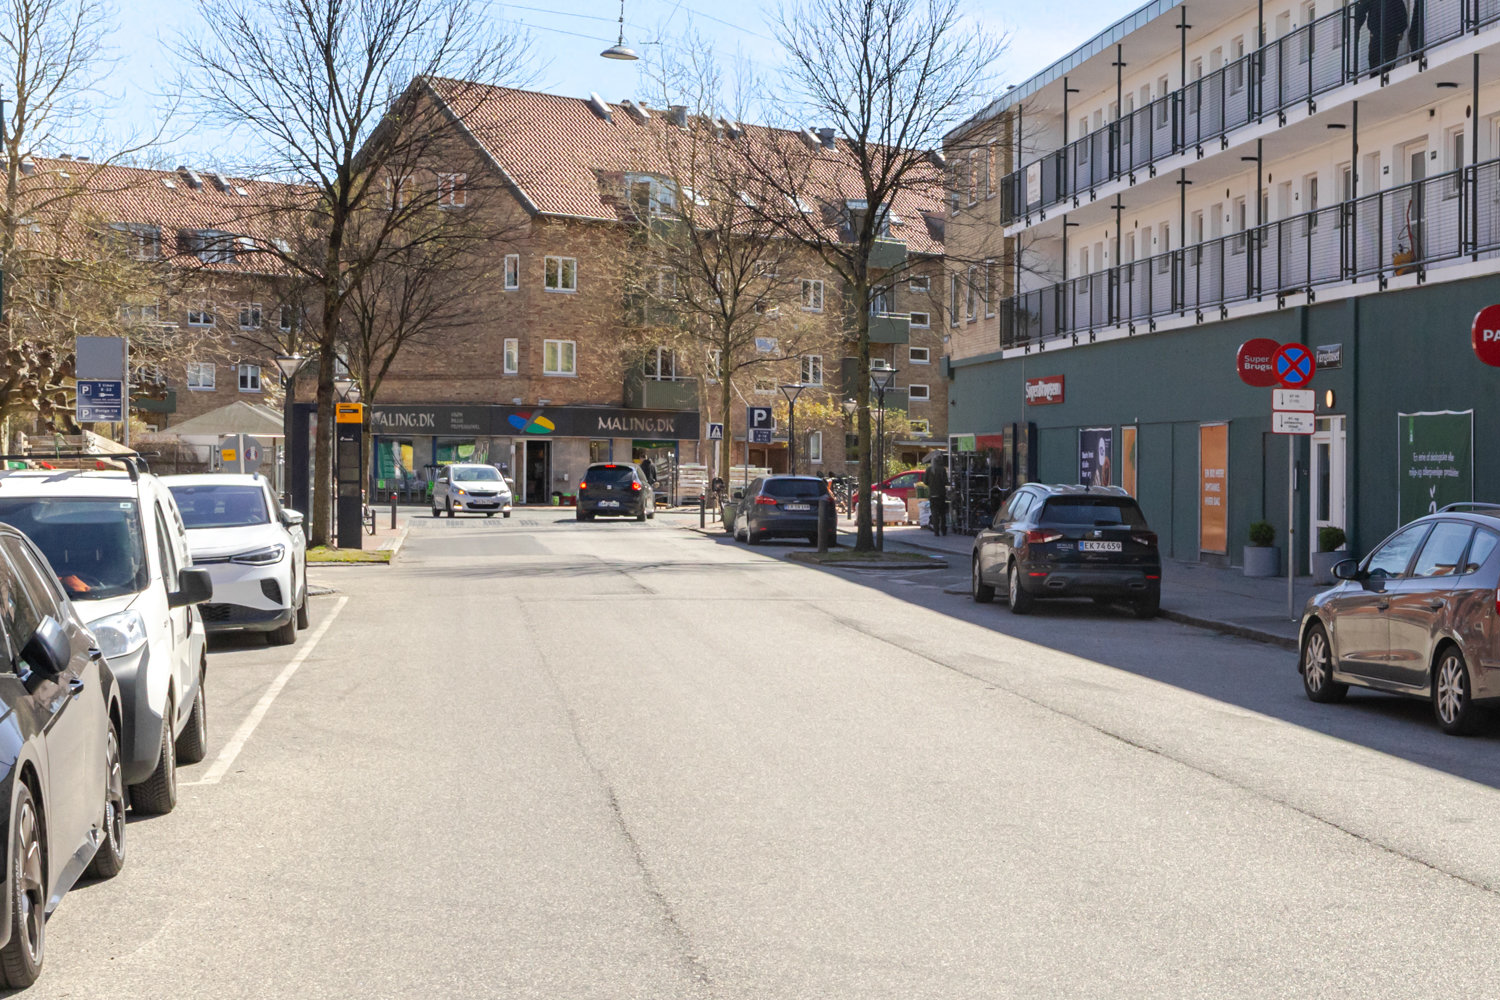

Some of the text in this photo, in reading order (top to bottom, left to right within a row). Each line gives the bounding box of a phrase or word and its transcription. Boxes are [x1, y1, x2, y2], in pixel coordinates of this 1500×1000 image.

[1244, 355, 1269, 364] Super
[82, 385, 90, 395] P
[82, 409, 90, 418] P
[753, 409, 767, 427] P
[598, 416, 675, 433] MALING.DK
[1084, 542, 1121, 551] EK 74 659
